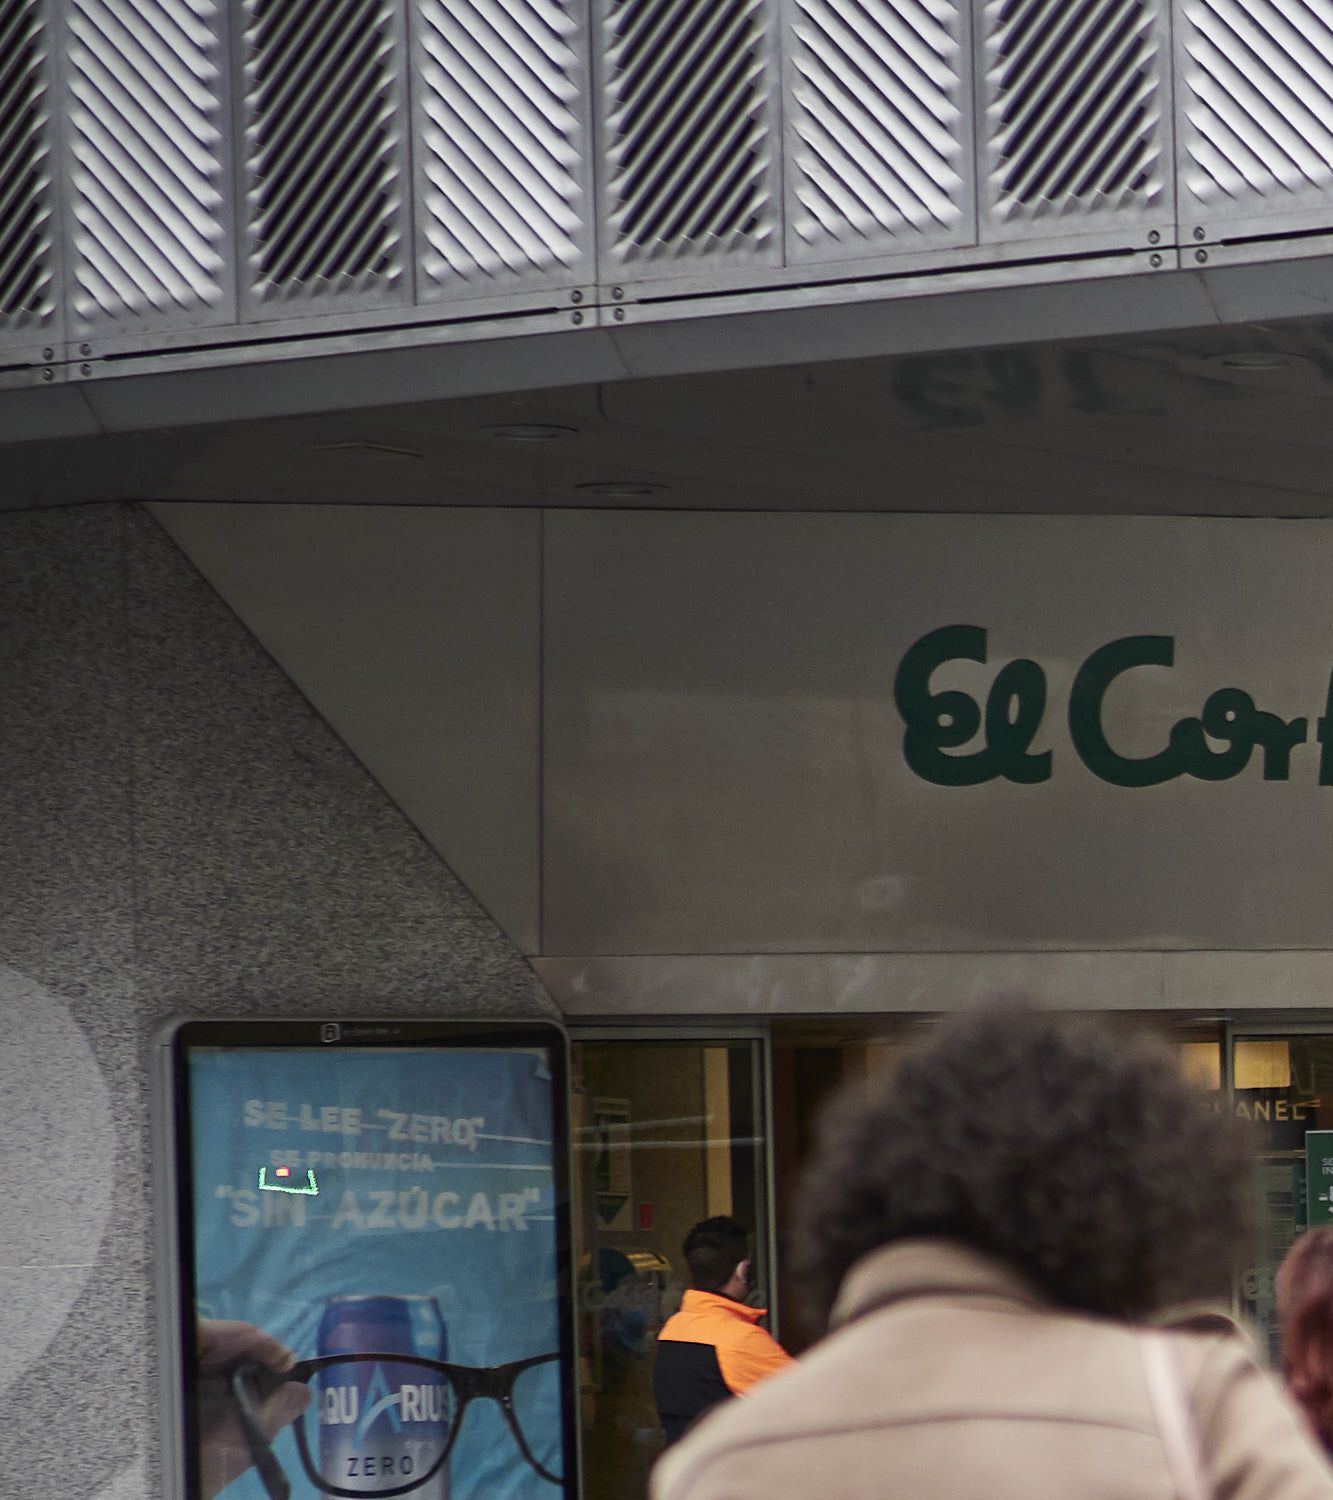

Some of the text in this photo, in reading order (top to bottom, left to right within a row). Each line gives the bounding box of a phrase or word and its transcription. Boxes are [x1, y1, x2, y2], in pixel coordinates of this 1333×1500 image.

[894, 624, 1053, 787] El
[243, 1100, 288, 1130] SE
[299, 1103, 363, 1136] LEE
[1234, 1099, 1307, 1121] ANEL
[347, 1455, 415, 1477] ZERO
